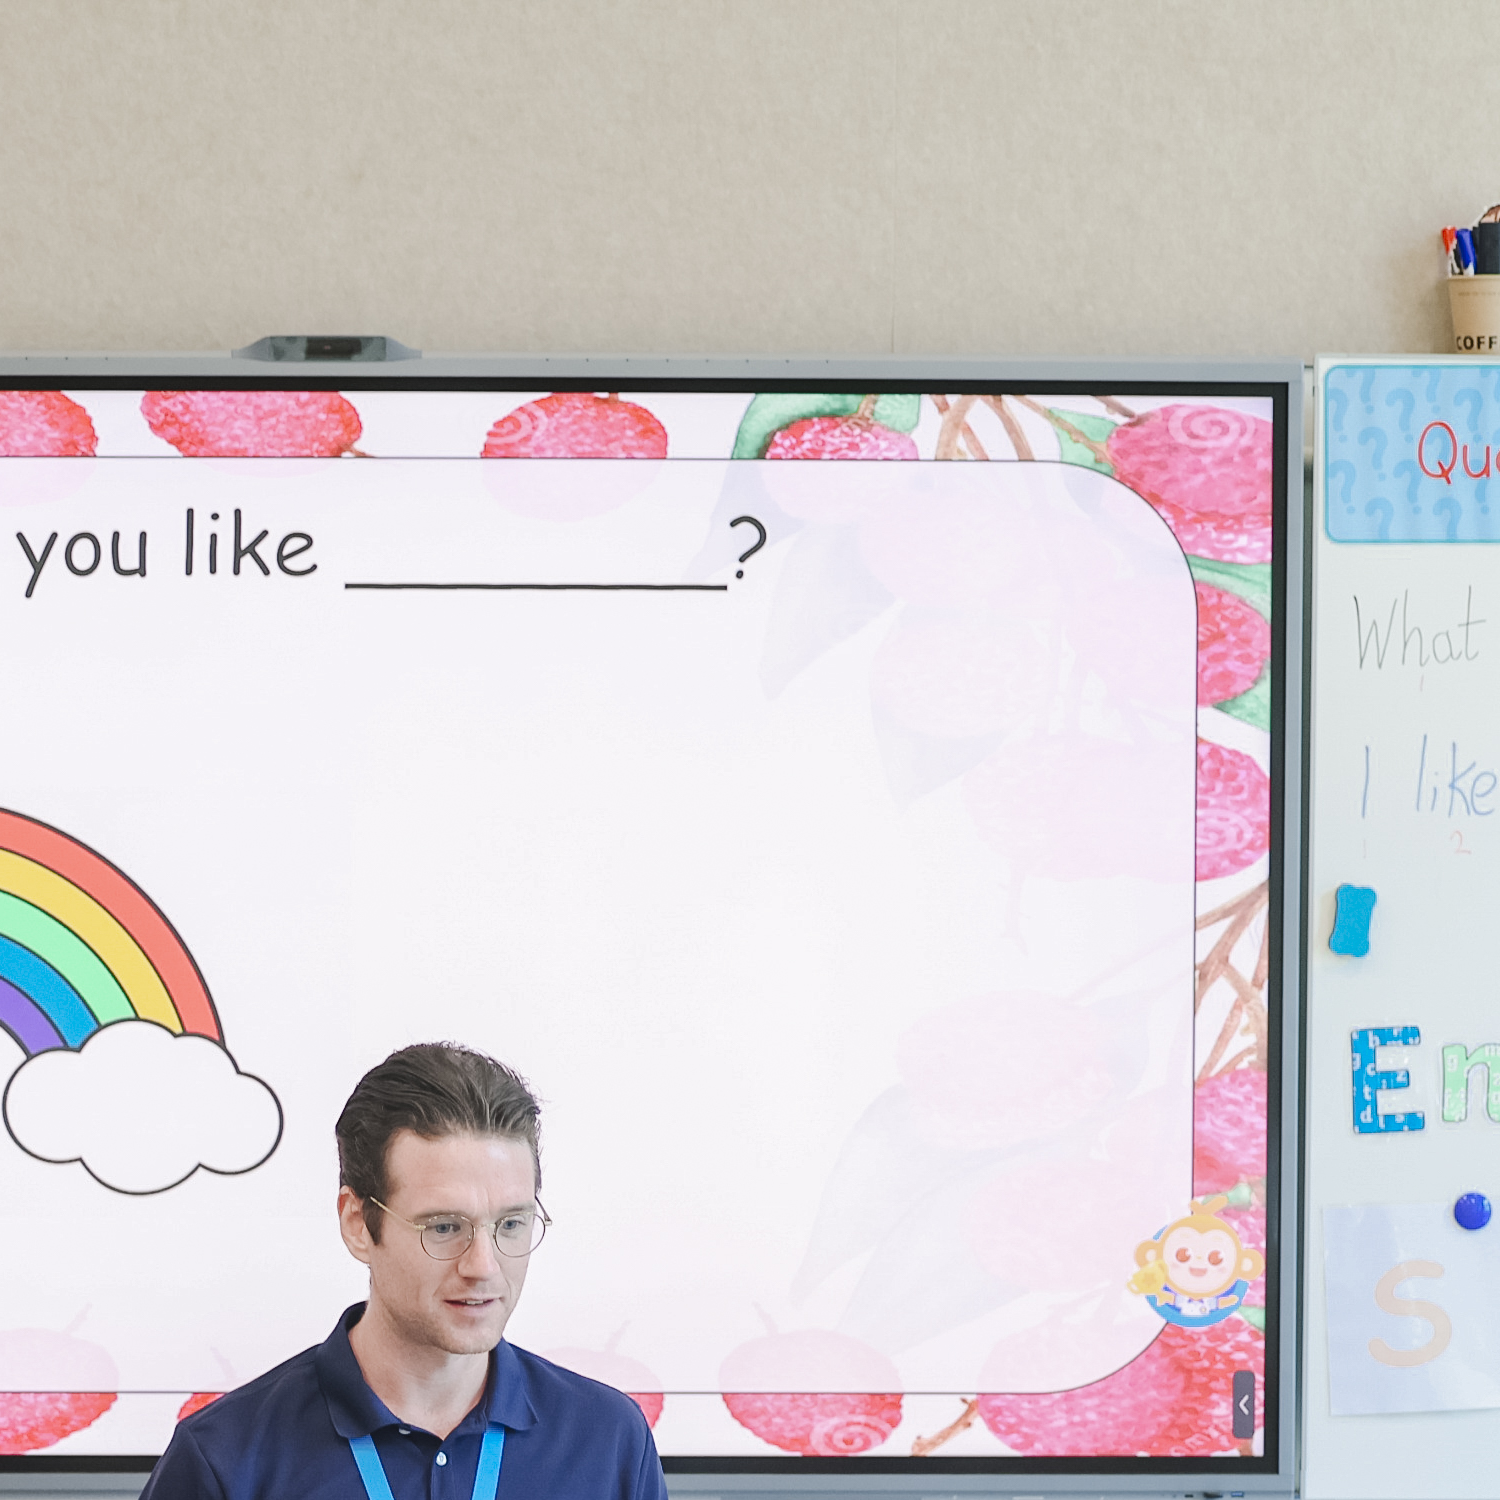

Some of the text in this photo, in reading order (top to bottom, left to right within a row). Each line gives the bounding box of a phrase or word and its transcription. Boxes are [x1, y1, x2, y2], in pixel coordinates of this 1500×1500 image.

[16, 530, 148, 598] you
[185, 507, 319, 578] like
[1353, 585, 1486, 670] What
